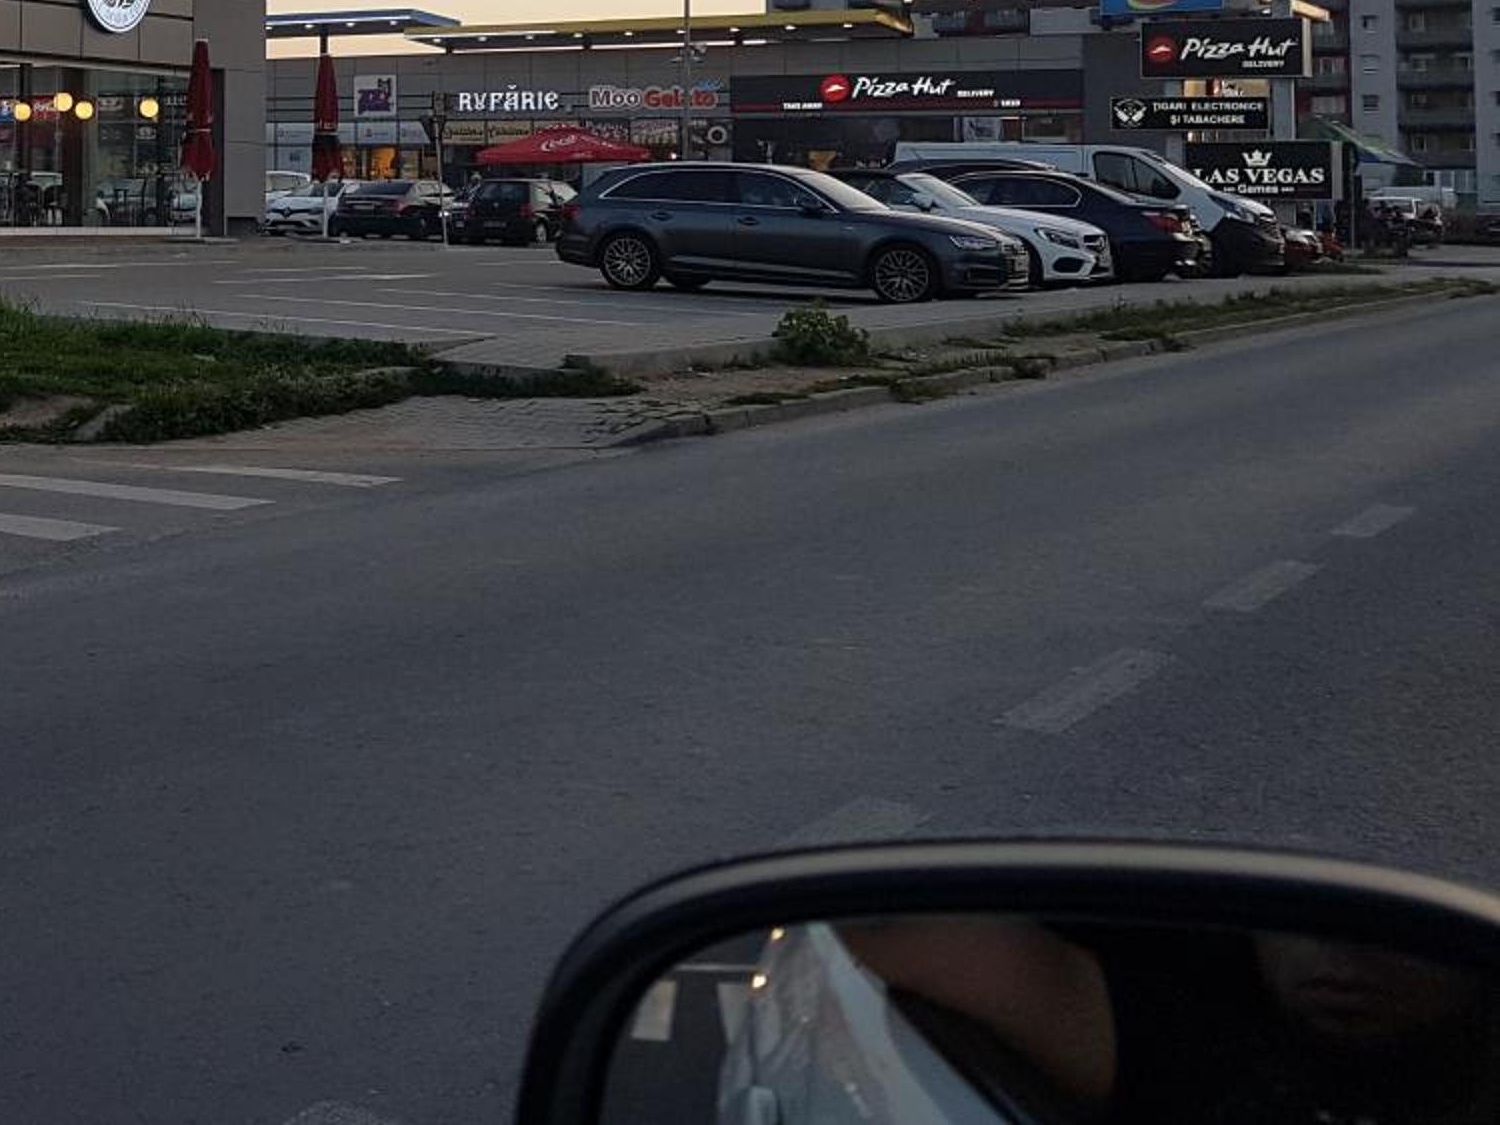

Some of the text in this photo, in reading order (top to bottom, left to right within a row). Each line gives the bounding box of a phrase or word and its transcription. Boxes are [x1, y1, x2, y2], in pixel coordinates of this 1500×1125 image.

[1180, 36, 1299, 60] Pizza Hut
[590, 85, 718, 110] Moo Gelto
[851, 76, 909, 99] Pizza
[911, 76, 956, 96] Hut
[1193, 168, 1325, 184] LAS VEGAS
[1237, 184, 1279, 194] Games
